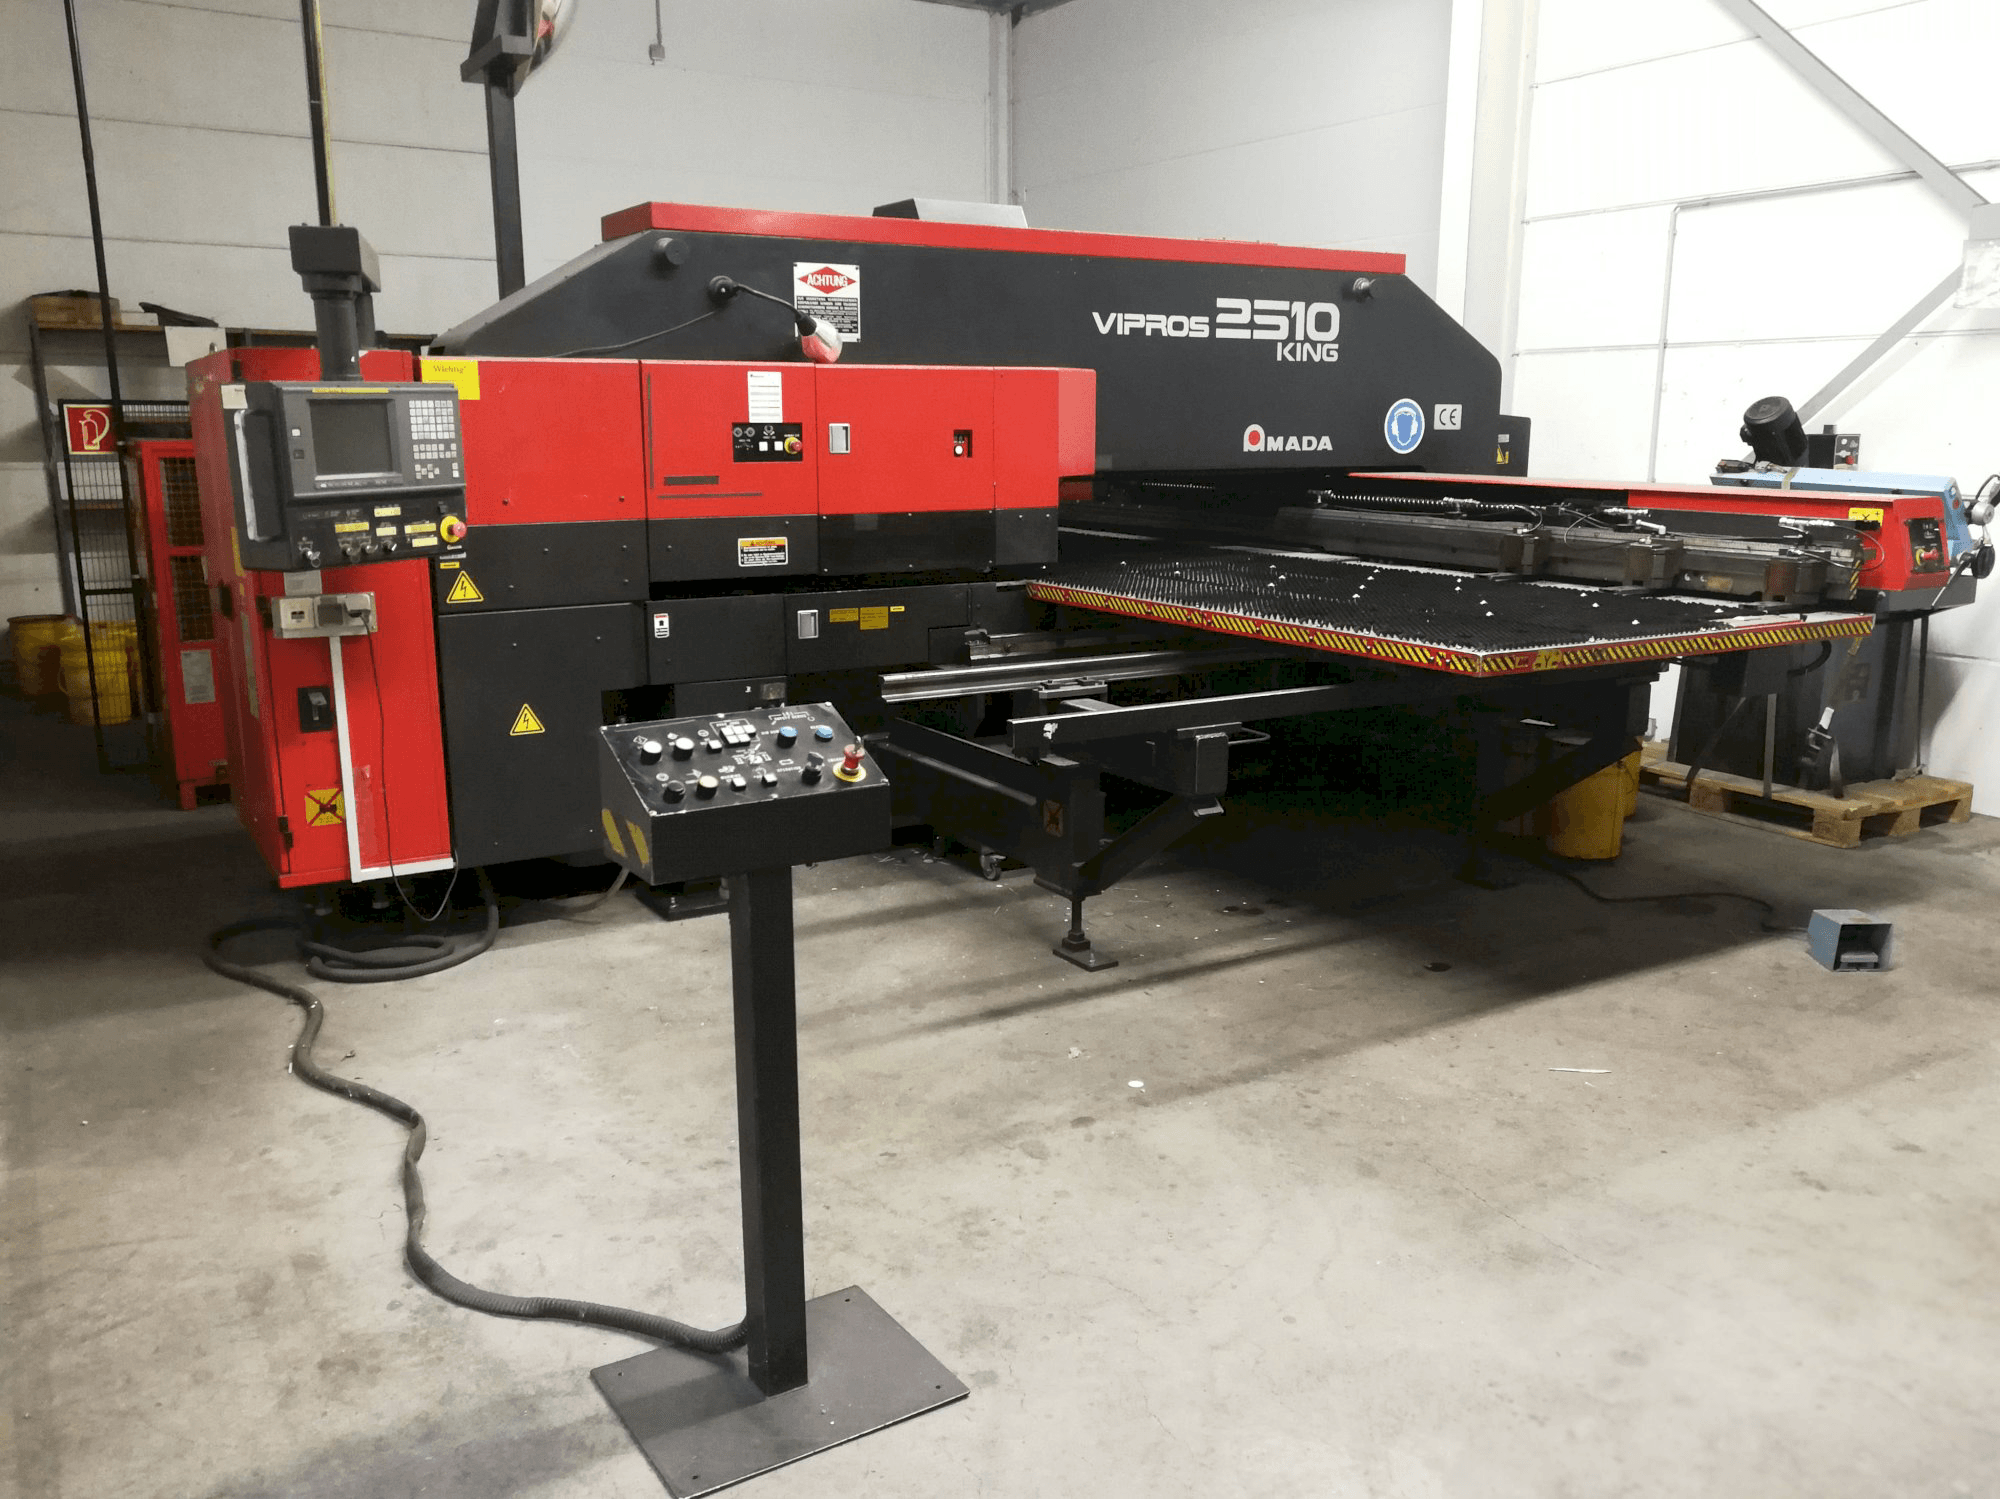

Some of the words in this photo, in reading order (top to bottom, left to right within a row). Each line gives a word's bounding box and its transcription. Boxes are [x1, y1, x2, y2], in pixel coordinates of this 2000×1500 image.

[807, 274, 848, 287] ACHTUNG
[1092, 312, 1209, 338] VIPROS
[1216, 297, 1340, 341] 2510
[1277, 342, 1339, 362] KING
[1439, 408, 1457, 426] CE
[1243, 424, 1333, 452] AMADA
